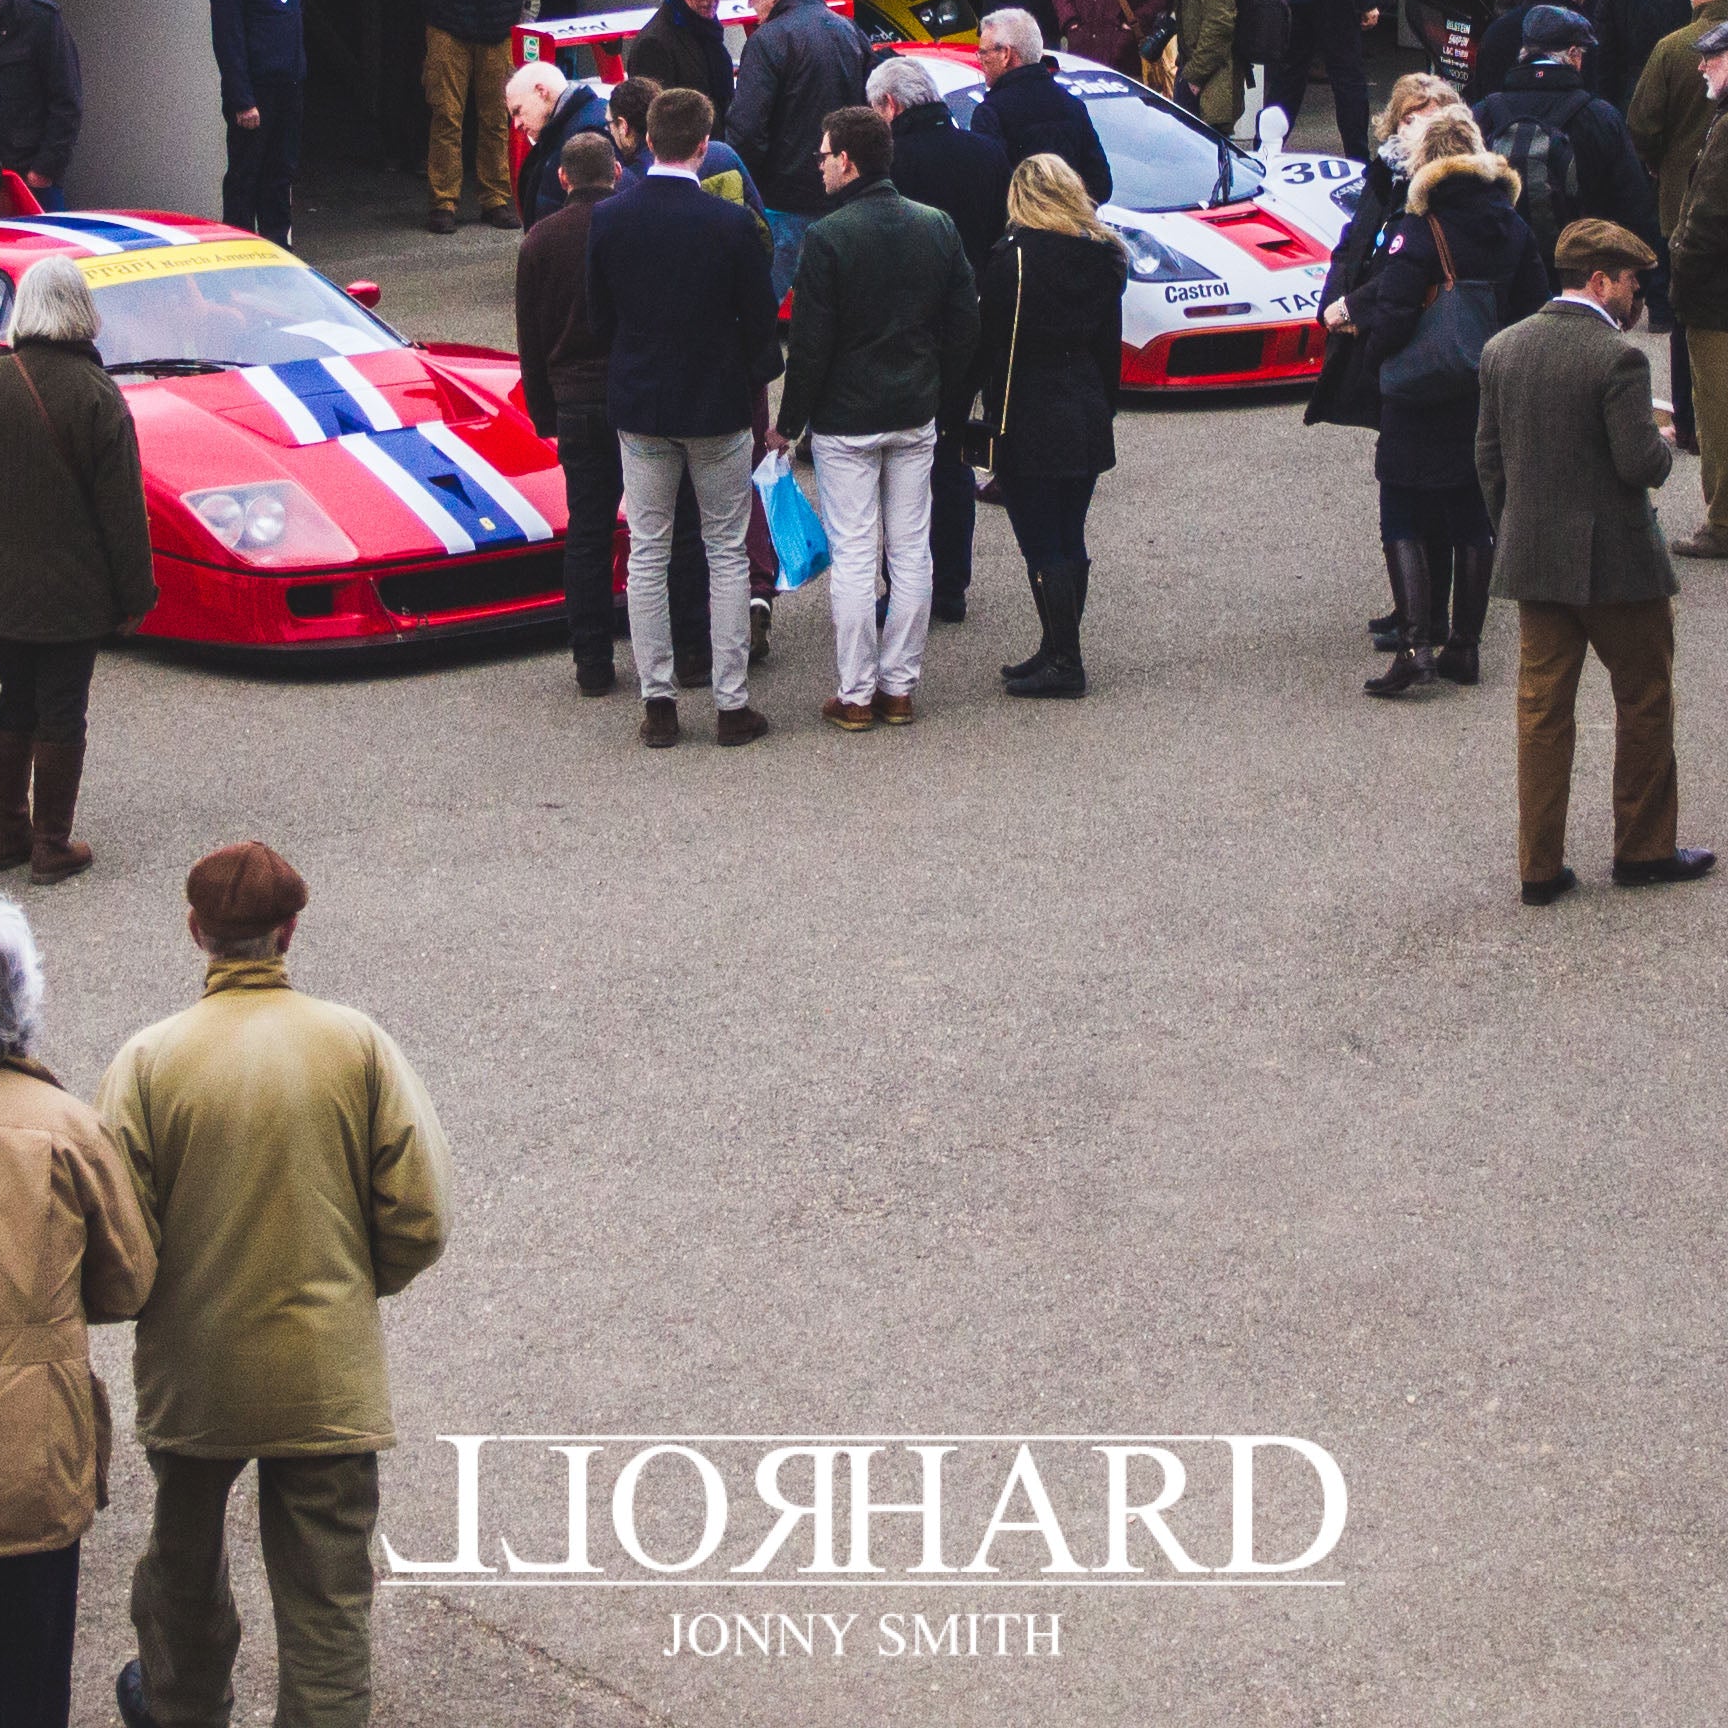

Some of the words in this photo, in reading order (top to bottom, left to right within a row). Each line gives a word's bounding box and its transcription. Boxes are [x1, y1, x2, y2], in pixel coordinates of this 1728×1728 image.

[1281, 159, 1352, 185] 30
[84, 256, 154, 281] rrari
[161, 255, 211, 270] North
[215, 250, 280, 264] America
[1164, 281, 1231, 304] Castrol
